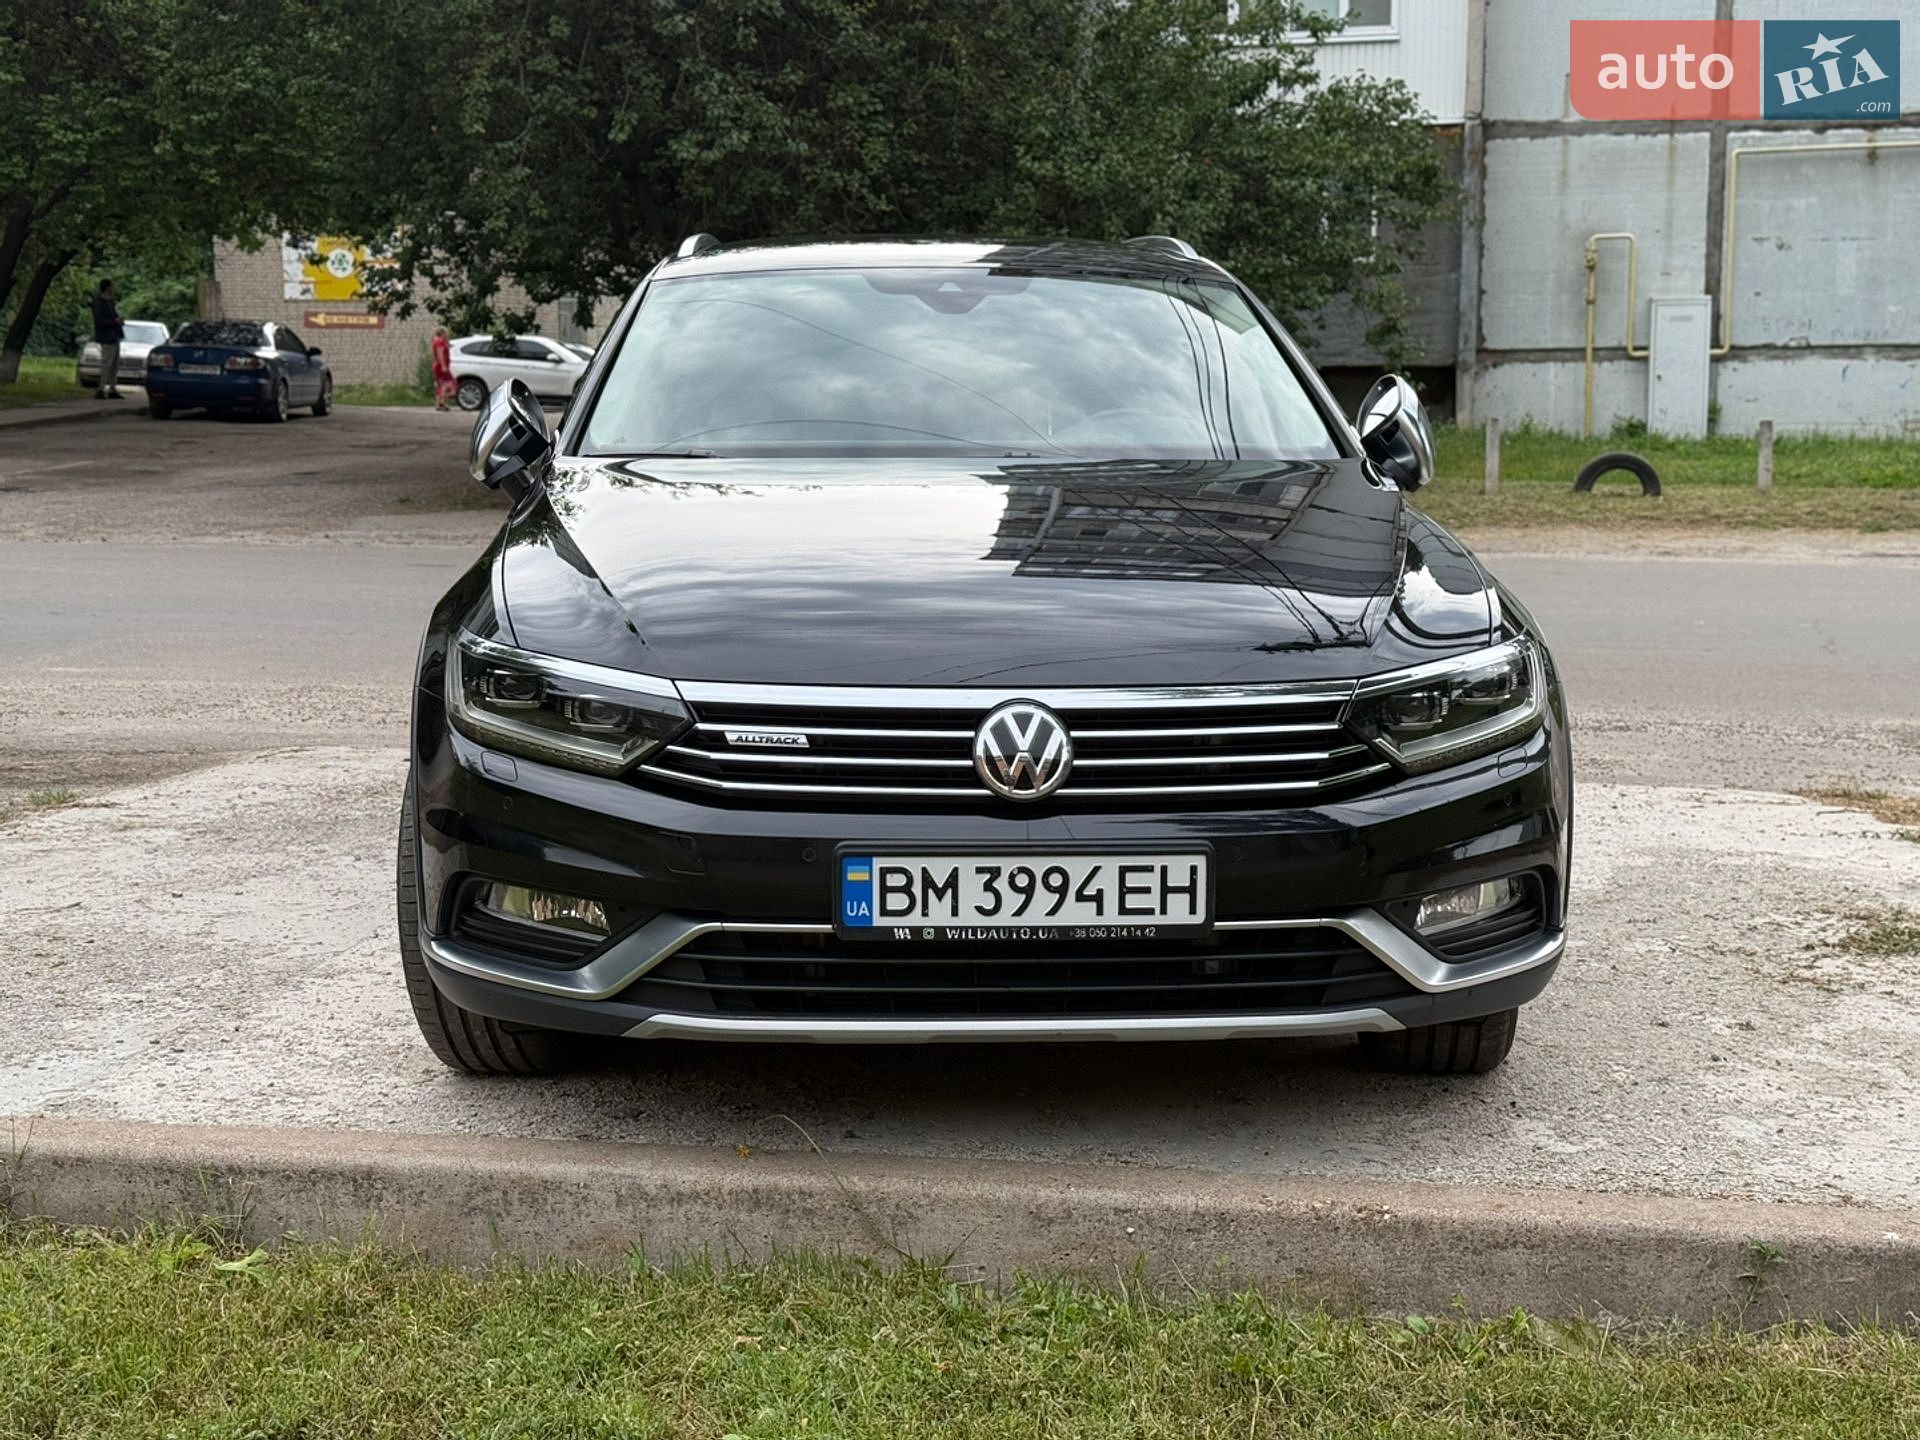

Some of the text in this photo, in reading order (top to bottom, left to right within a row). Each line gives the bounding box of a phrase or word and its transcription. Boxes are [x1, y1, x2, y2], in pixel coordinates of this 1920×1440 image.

[735, 735, 801, 745] ALLTRACK
[879, 864, 1197, 918] BM 3994 EH
[846, 901, 870, 917] UA
